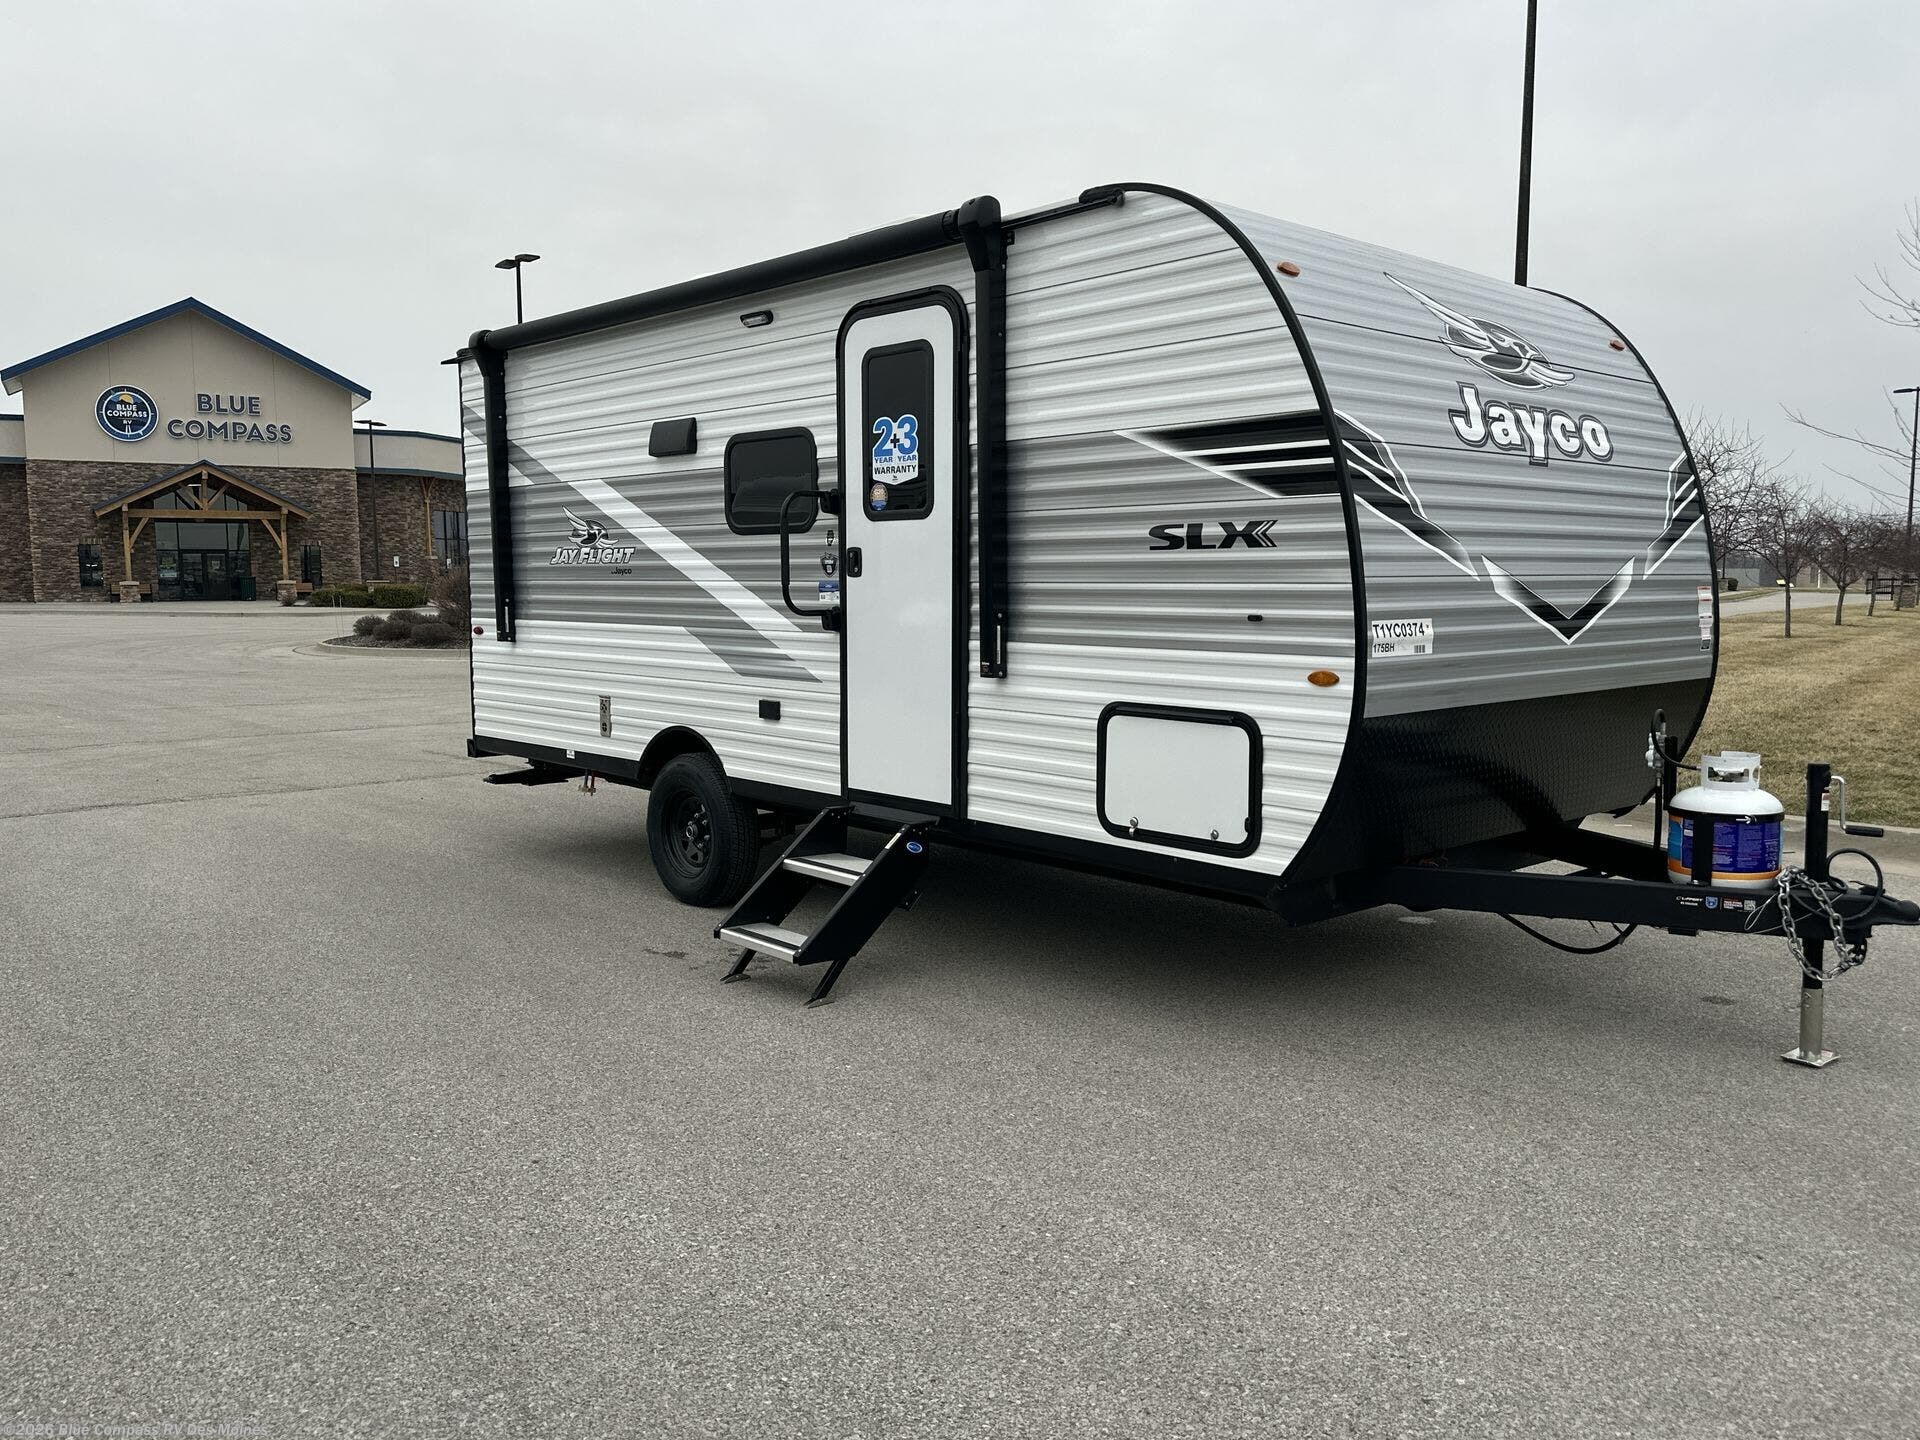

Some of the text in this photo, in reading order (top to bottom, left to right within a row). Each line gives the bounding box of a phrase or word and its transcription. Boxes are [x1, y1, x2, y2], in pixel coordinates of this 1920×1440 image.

[197, 394, 261, 415] BLUE
[107, 410, 148, 418] COMPASS
[168, 419, 292, 443] COMPASS
[1449, 381, 1614, 467] Jayco
[897, 454, 917, 462] YEAR
[874, 465, 917, 475] WARRANTY
[1148, 520, 1278, 550] SLX
[550, 547, 635, 565] JAY FLIGHT
[1373, 622, 1425, 639] T1YC0374
[1373, 643, 1395, 653] 175BH
